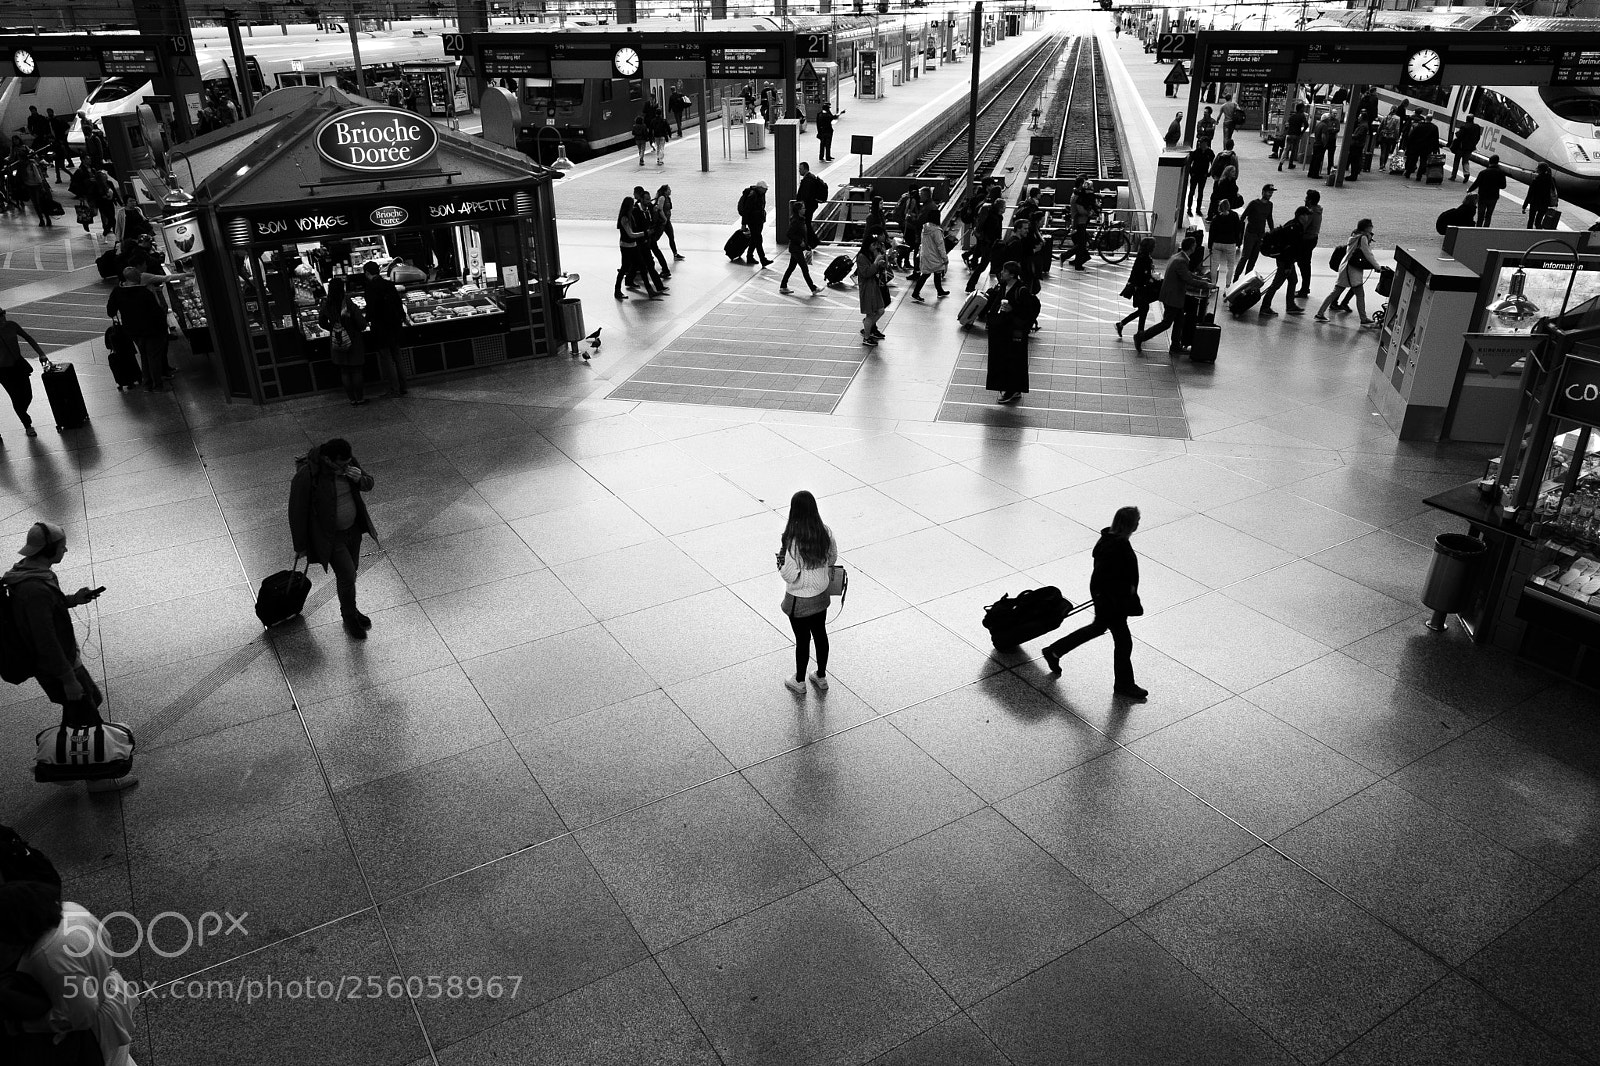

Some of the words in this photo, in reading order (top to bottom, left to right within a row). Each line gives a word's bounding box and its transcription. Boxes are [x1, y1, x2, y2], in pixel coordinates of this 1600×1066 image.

[170, 36, 186, 52] 19
[446, 34, 464, 51] 20
[809, 34, 825, 53] 21
[1161, 34, 1186, 53] 22
[334, 118, 421, 145] Brioche
[1481, 126, 1500, 153] ICE
[349, 141, 412, 164] Dorée
[375, 208, 403, 219] Brioche
[429, 203, 455, 218] BON
[458, 198, 509, 215] APPETIT
[256, 219, 288, 235] BON
[294, 215, 349, 232] VOYAGE
[1542, 261, 1584, 270] Informatin
